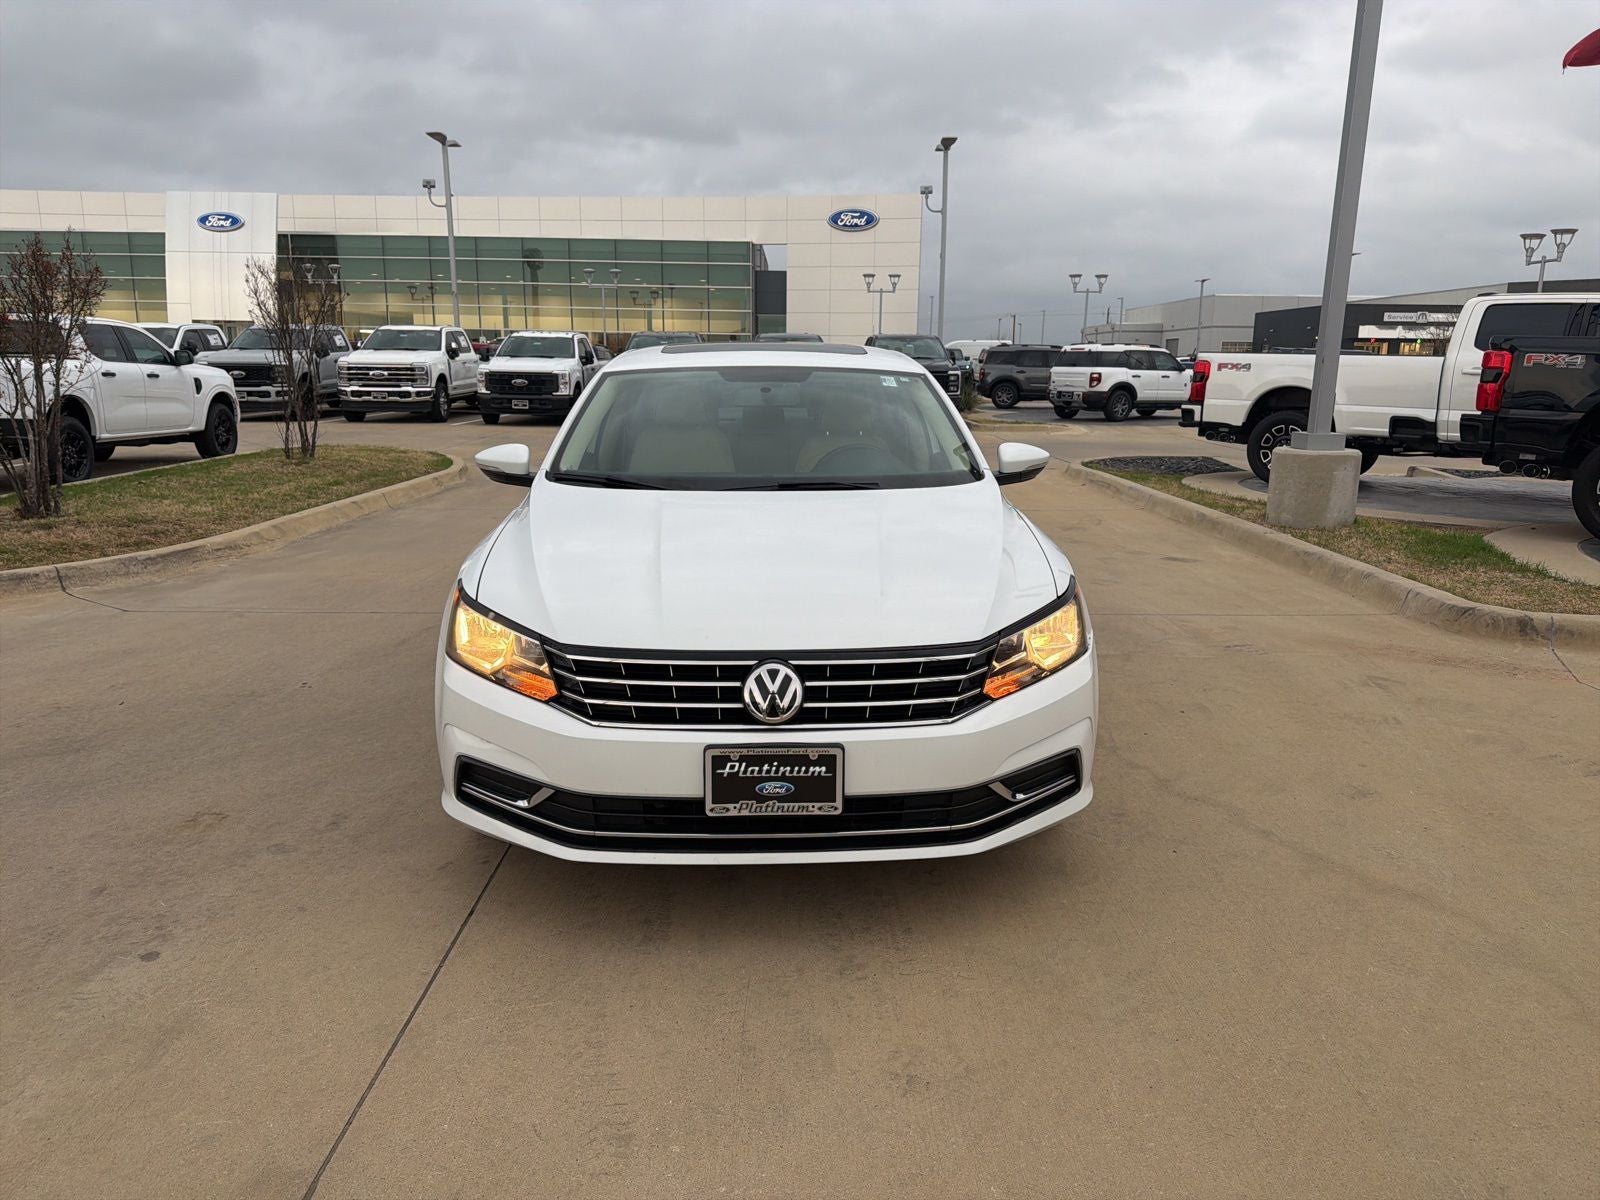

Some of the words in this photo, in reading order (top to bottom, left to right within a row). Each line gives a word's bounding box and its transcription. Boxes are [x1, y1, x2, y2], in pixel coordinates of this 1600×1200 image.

[205, 215, 232, 227] Ford
[837, 212, 868, 226] Ford
[1523, 353, 1586, 367] FX4
[1217, 363, 1251, 372] FX4
[716, 762, 833, 777] Platinum
[763, 783, 787, 794] Ford
[738, 802, 815, 814] Platinum
